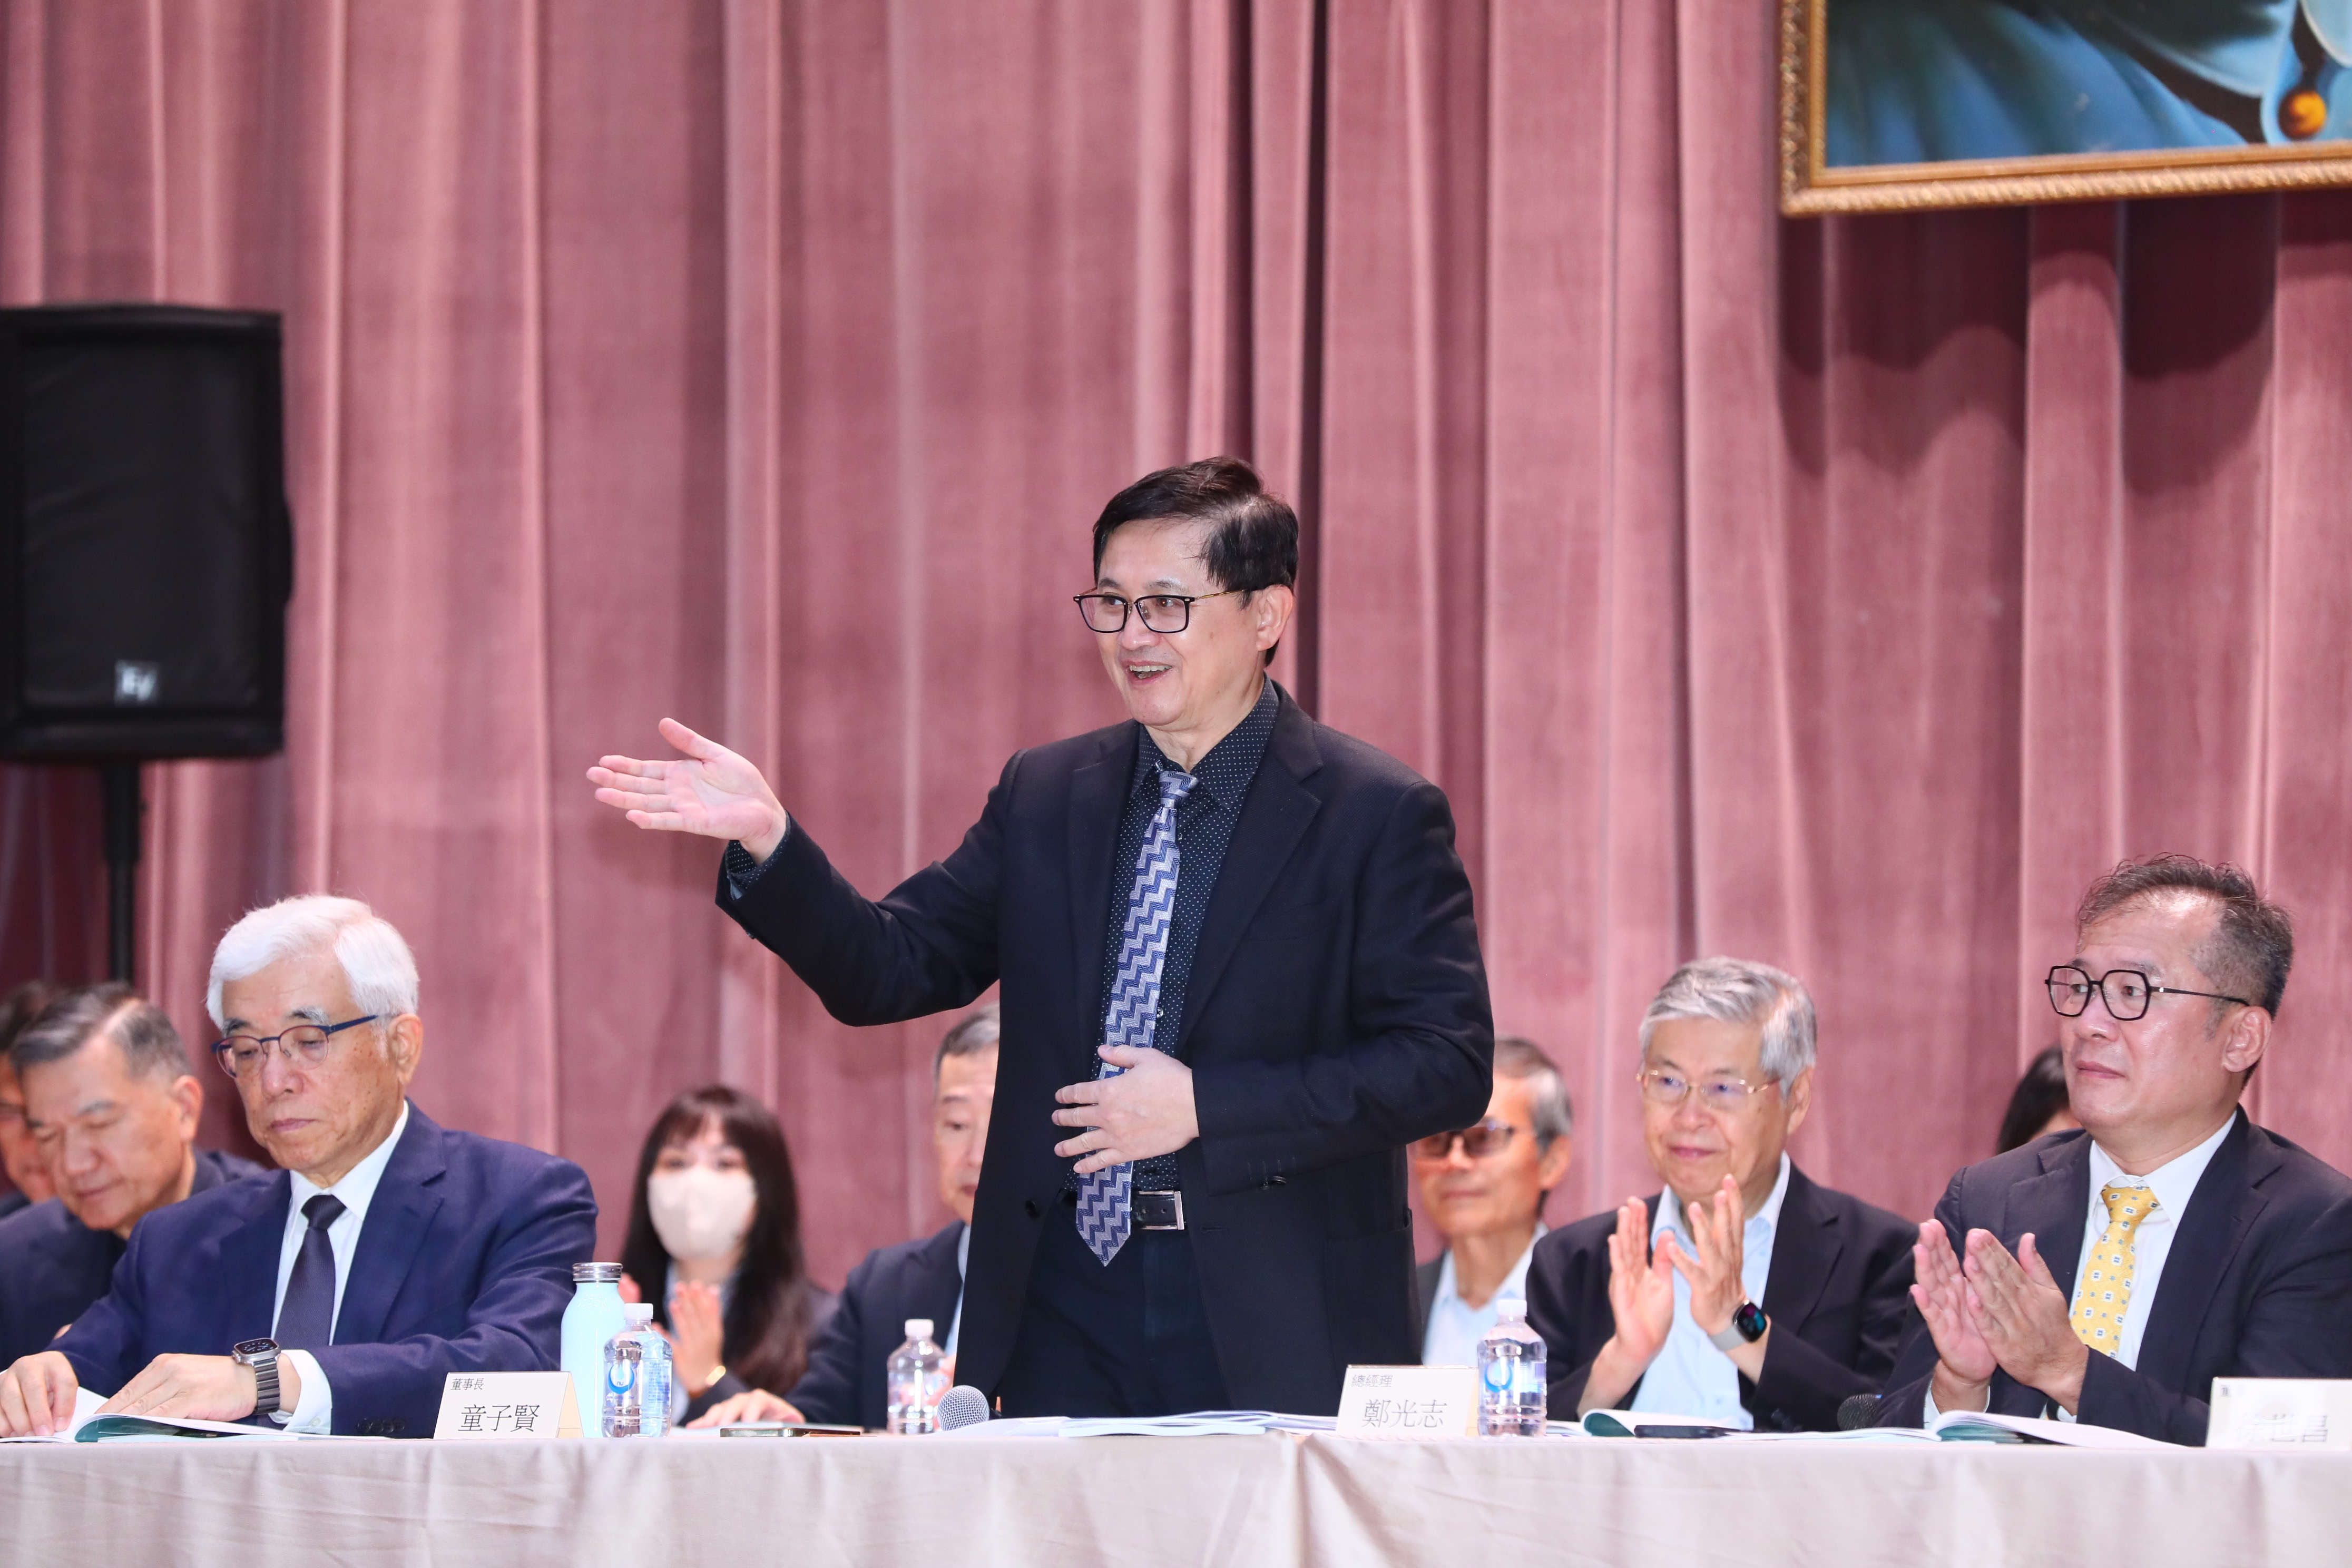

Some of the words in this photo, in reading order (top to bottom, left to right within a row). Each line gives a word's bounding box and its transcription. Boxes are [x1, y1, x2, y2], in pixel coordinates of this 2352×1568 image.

[450, 1378, 484, 1390] 董事長
[1351, 1374, 1393, 1387] 總經理
[458, 1404, 540, 1432] 童子賢
[1361, 1399, 1447, 1428] 鄭光志
